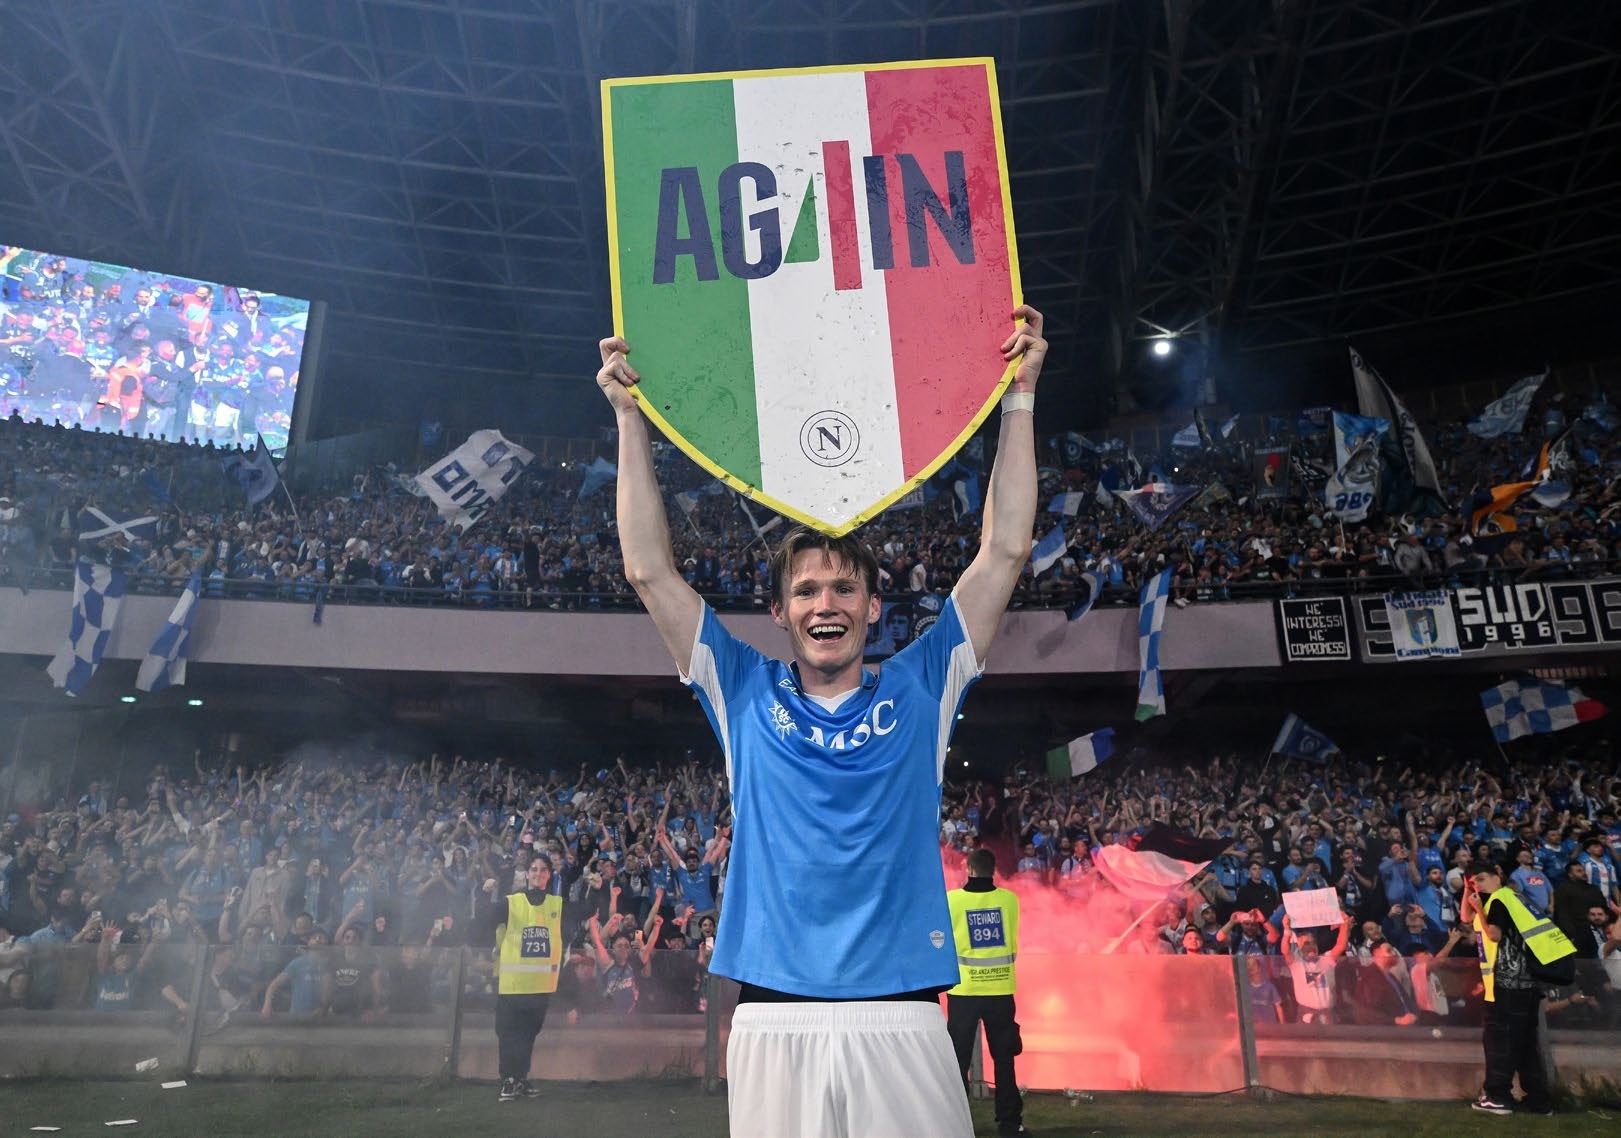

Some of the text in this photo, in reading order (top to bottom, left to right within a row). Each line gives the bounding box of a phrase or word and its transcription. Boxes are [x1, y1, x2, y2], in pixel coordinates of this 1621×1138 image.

[815, 425, 842, 452] N
[1456, 583, 1546, 625] SUD
[1286, 615, 1344, 630] INTERESSI
[1464, 621, 1552, 642] 1996
[1290, 641, 1347, 656] COMPROMESSI
[968, 911, 1001, 926] STEWARD
[973, 927, 1000, 942] 894
[525, 941, 547, 953] 731
